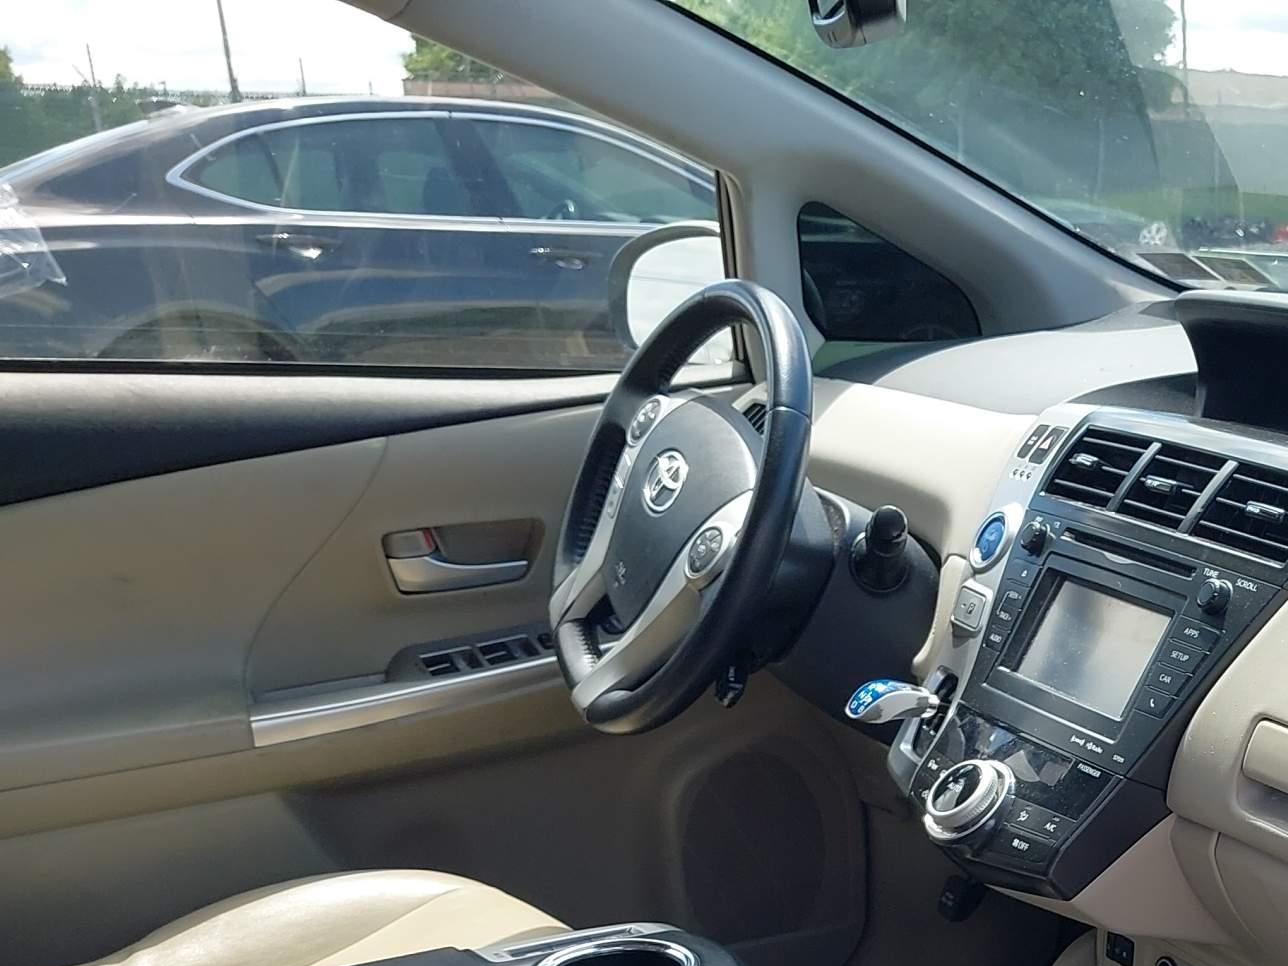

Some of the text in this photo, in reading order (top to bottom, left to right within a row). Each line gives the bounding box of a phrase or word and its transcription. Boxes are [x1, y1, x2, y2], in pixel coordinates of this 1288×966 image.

[1203, 567, 1220, 579] TUNE
[1235, 578, 1258, 592] SCROLL
[1184, 627, 1200, 639] APPS
[1170, 650, 1190, 662] SETUP
[1160, 673, 1172, 684] CAR
[1043, 822, 1057, 832] A/C
